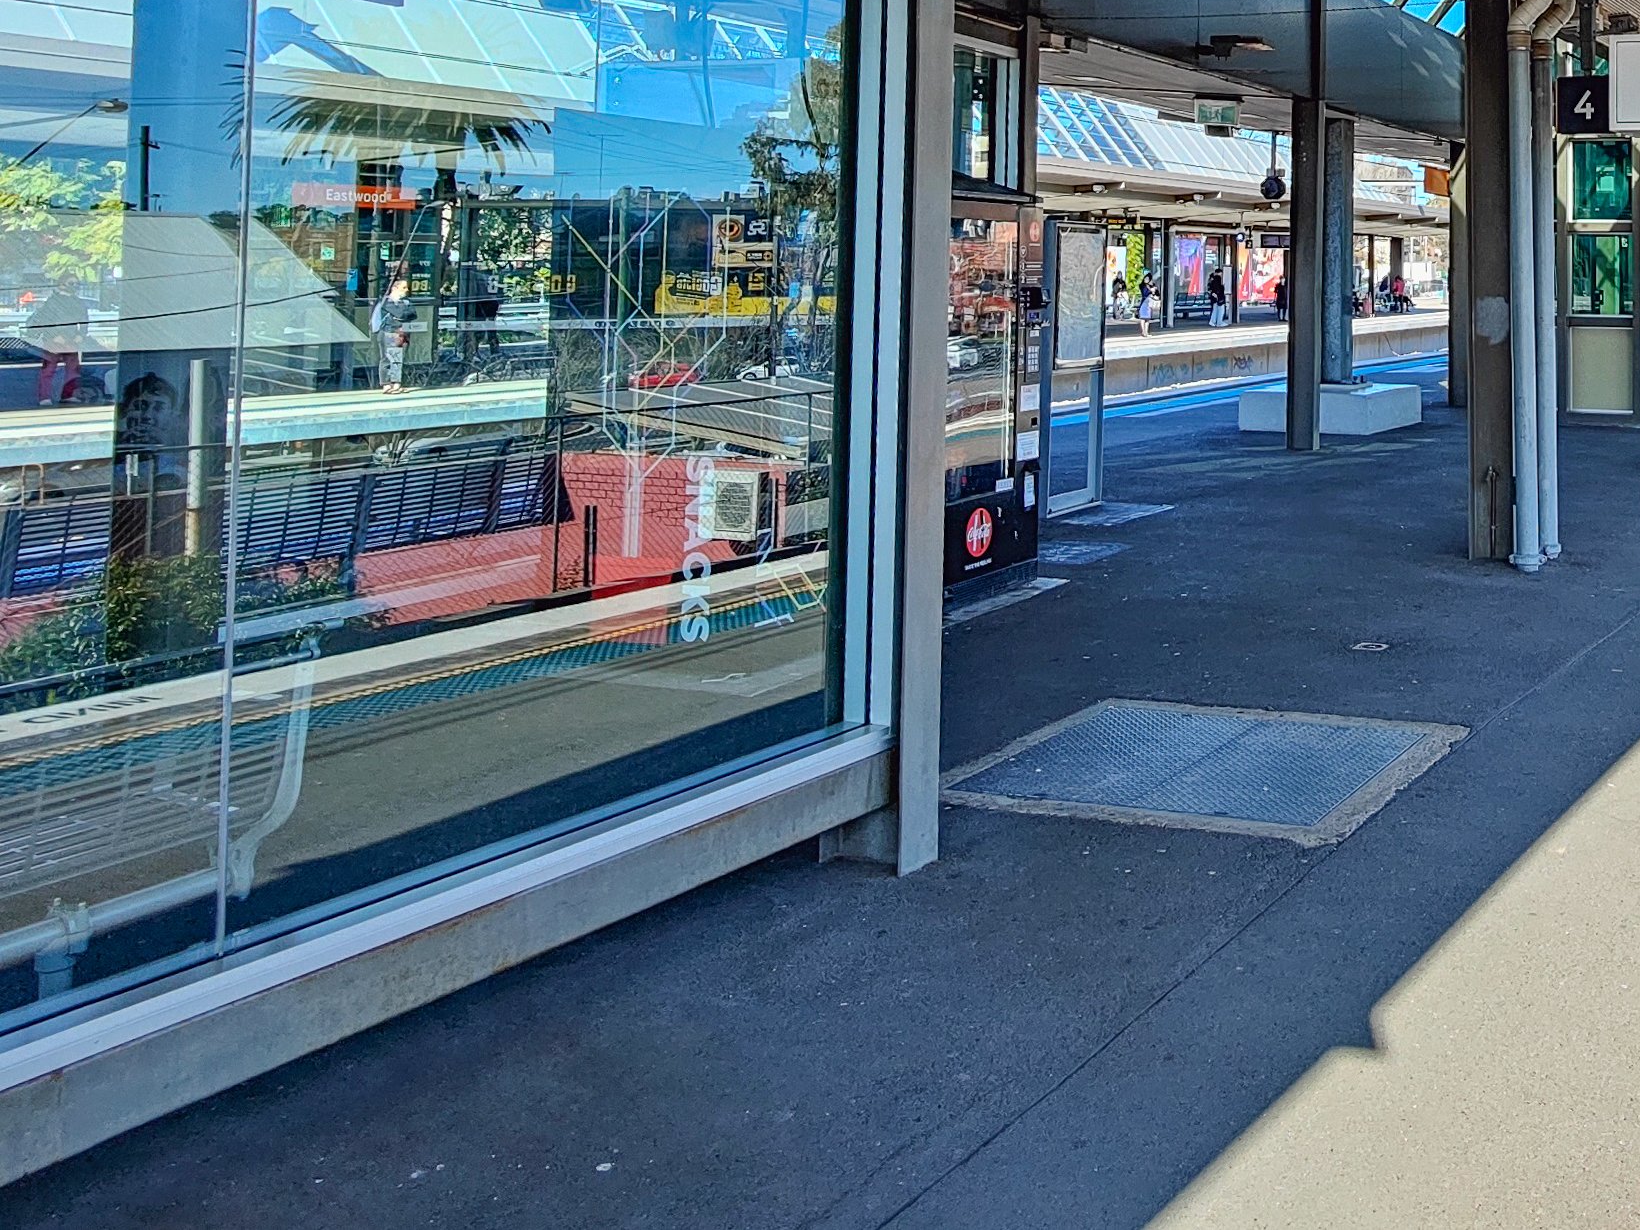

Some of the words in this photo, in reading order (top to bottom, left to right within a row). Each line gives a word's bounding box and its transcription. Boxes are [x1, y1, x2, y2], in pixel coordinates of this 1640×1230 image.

[1573, 89, 1595, 120] 4
[326, 188, 387, 203] Eastwood
[680, 456, 715, 643] SNACKS
